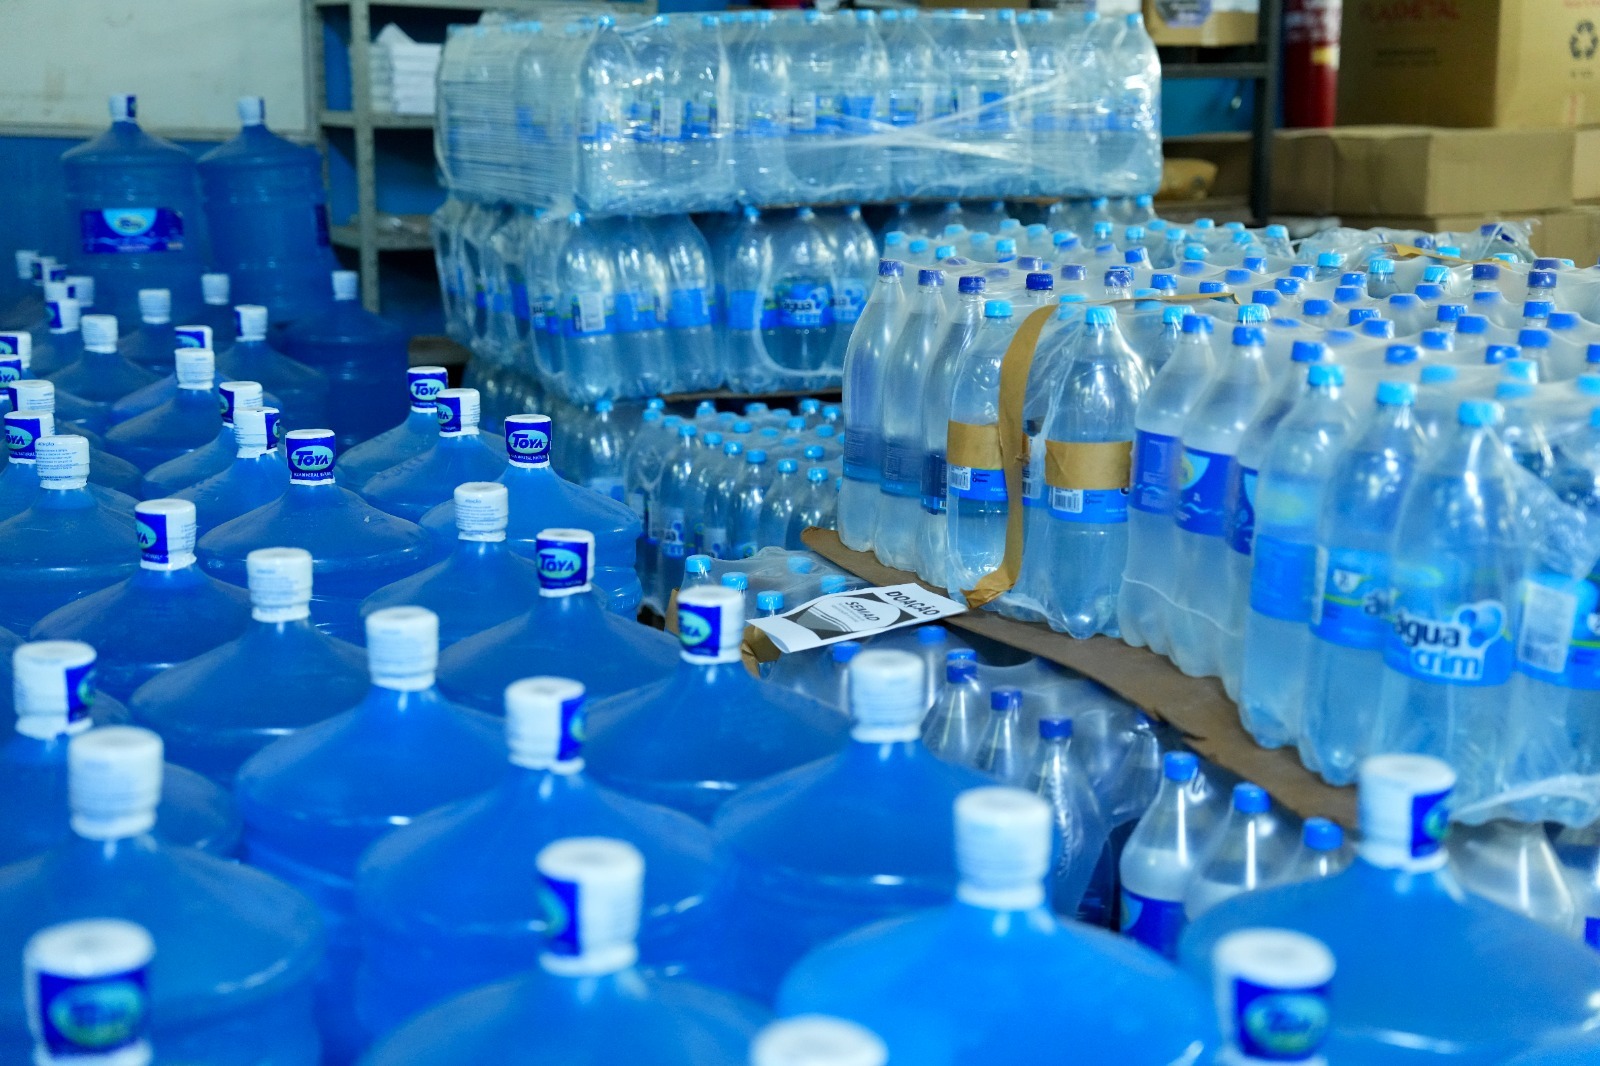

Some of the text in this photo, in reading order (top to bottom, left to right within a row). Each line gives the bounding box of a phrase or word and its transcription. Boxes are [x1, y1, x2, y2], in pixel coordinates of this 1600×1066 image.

[512, 433, 543, 449] TOYA
[295, 450, 329, 466] TOYA
[539, 553, 574, 572] TOYA
[884, 590, 941, 616] DOAÇÃO
